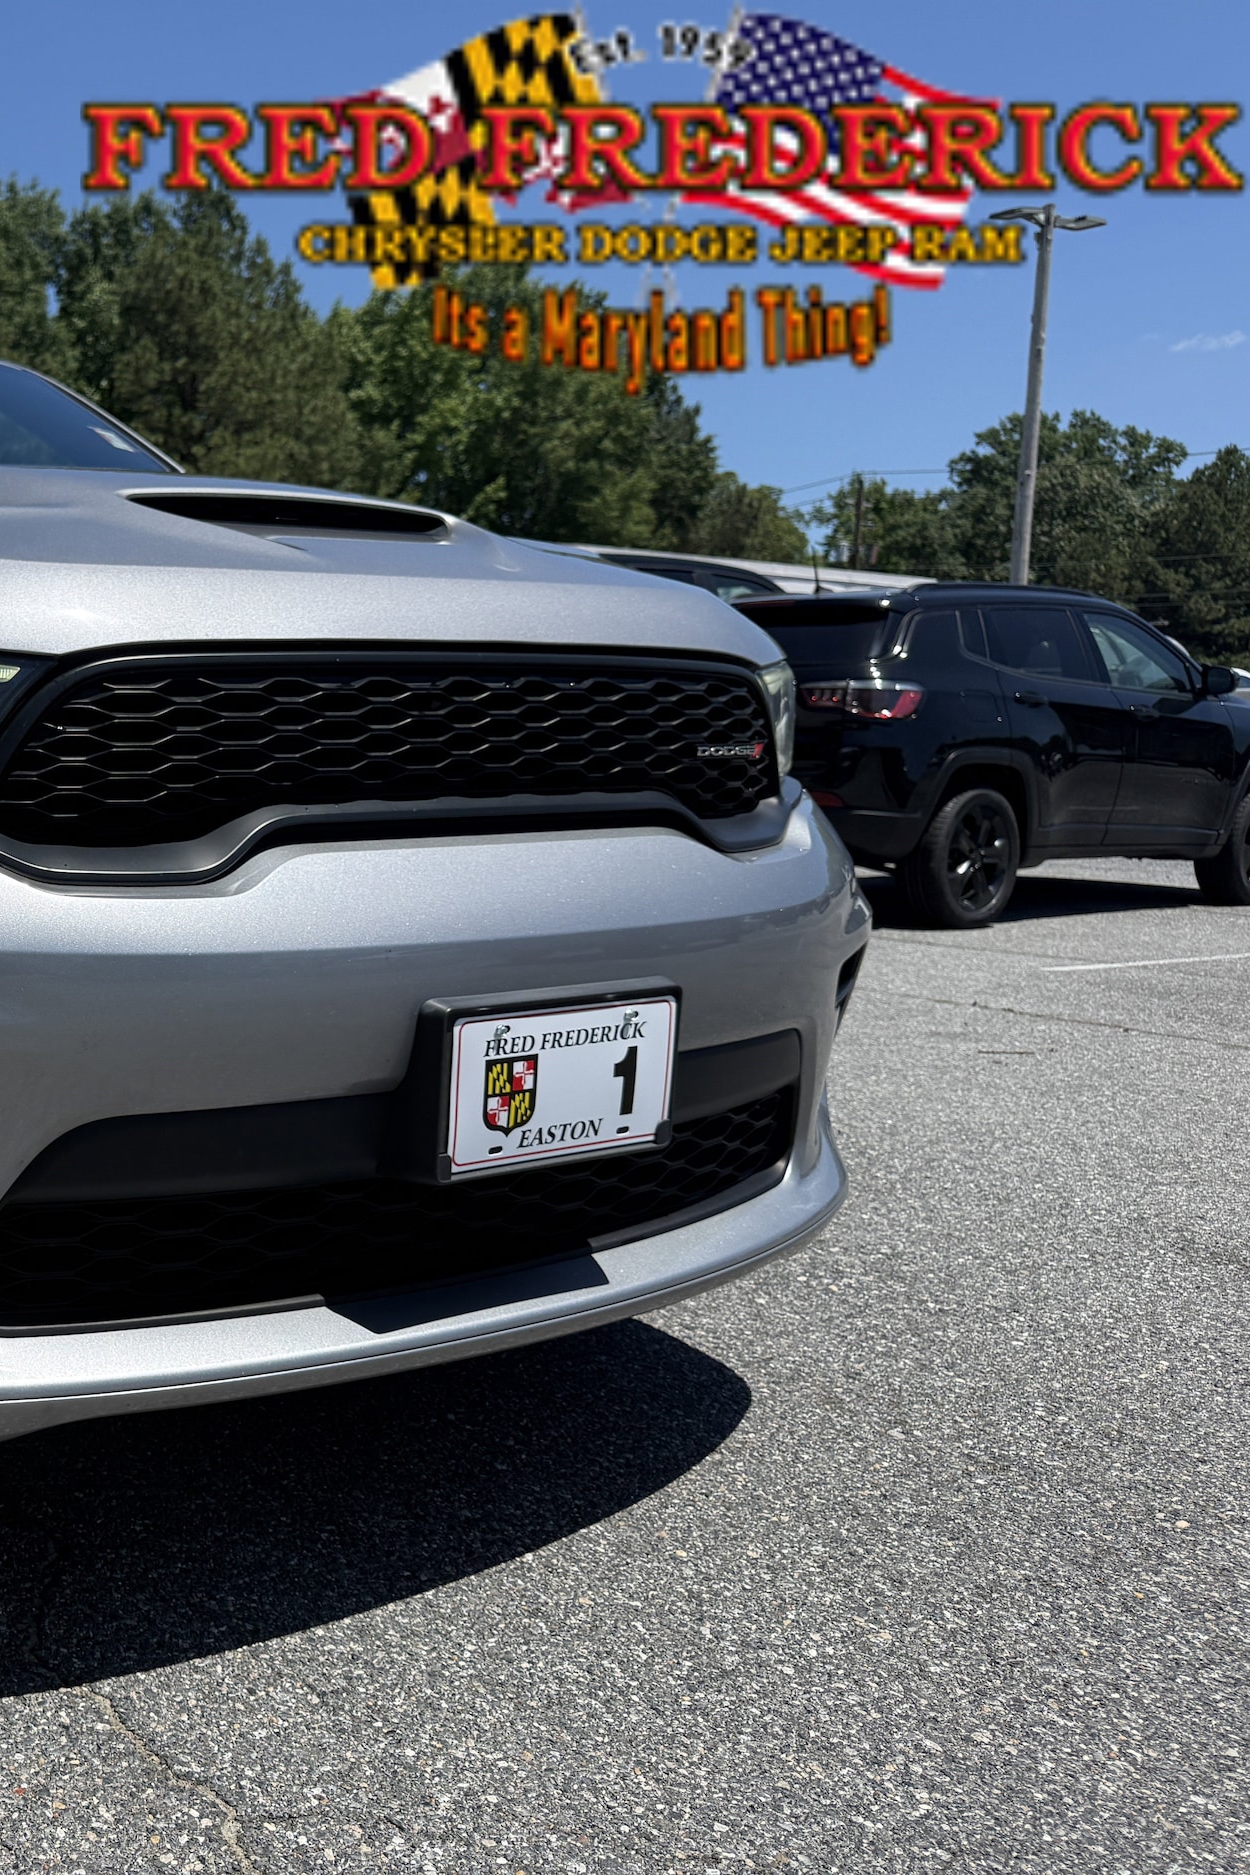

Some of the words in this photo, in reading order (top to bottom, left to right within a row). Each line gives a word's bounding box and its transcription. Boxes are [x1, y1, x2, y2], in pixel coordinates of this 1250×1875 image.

[696, 744, 756, 757] DODGE
[483, 1034, 535, 1057] FRED
[539, 1021, 647, 1050] FREDERICK
[613, 1046, 638, 1115] 1
[517, 1118, 603, 1148] EASTON
